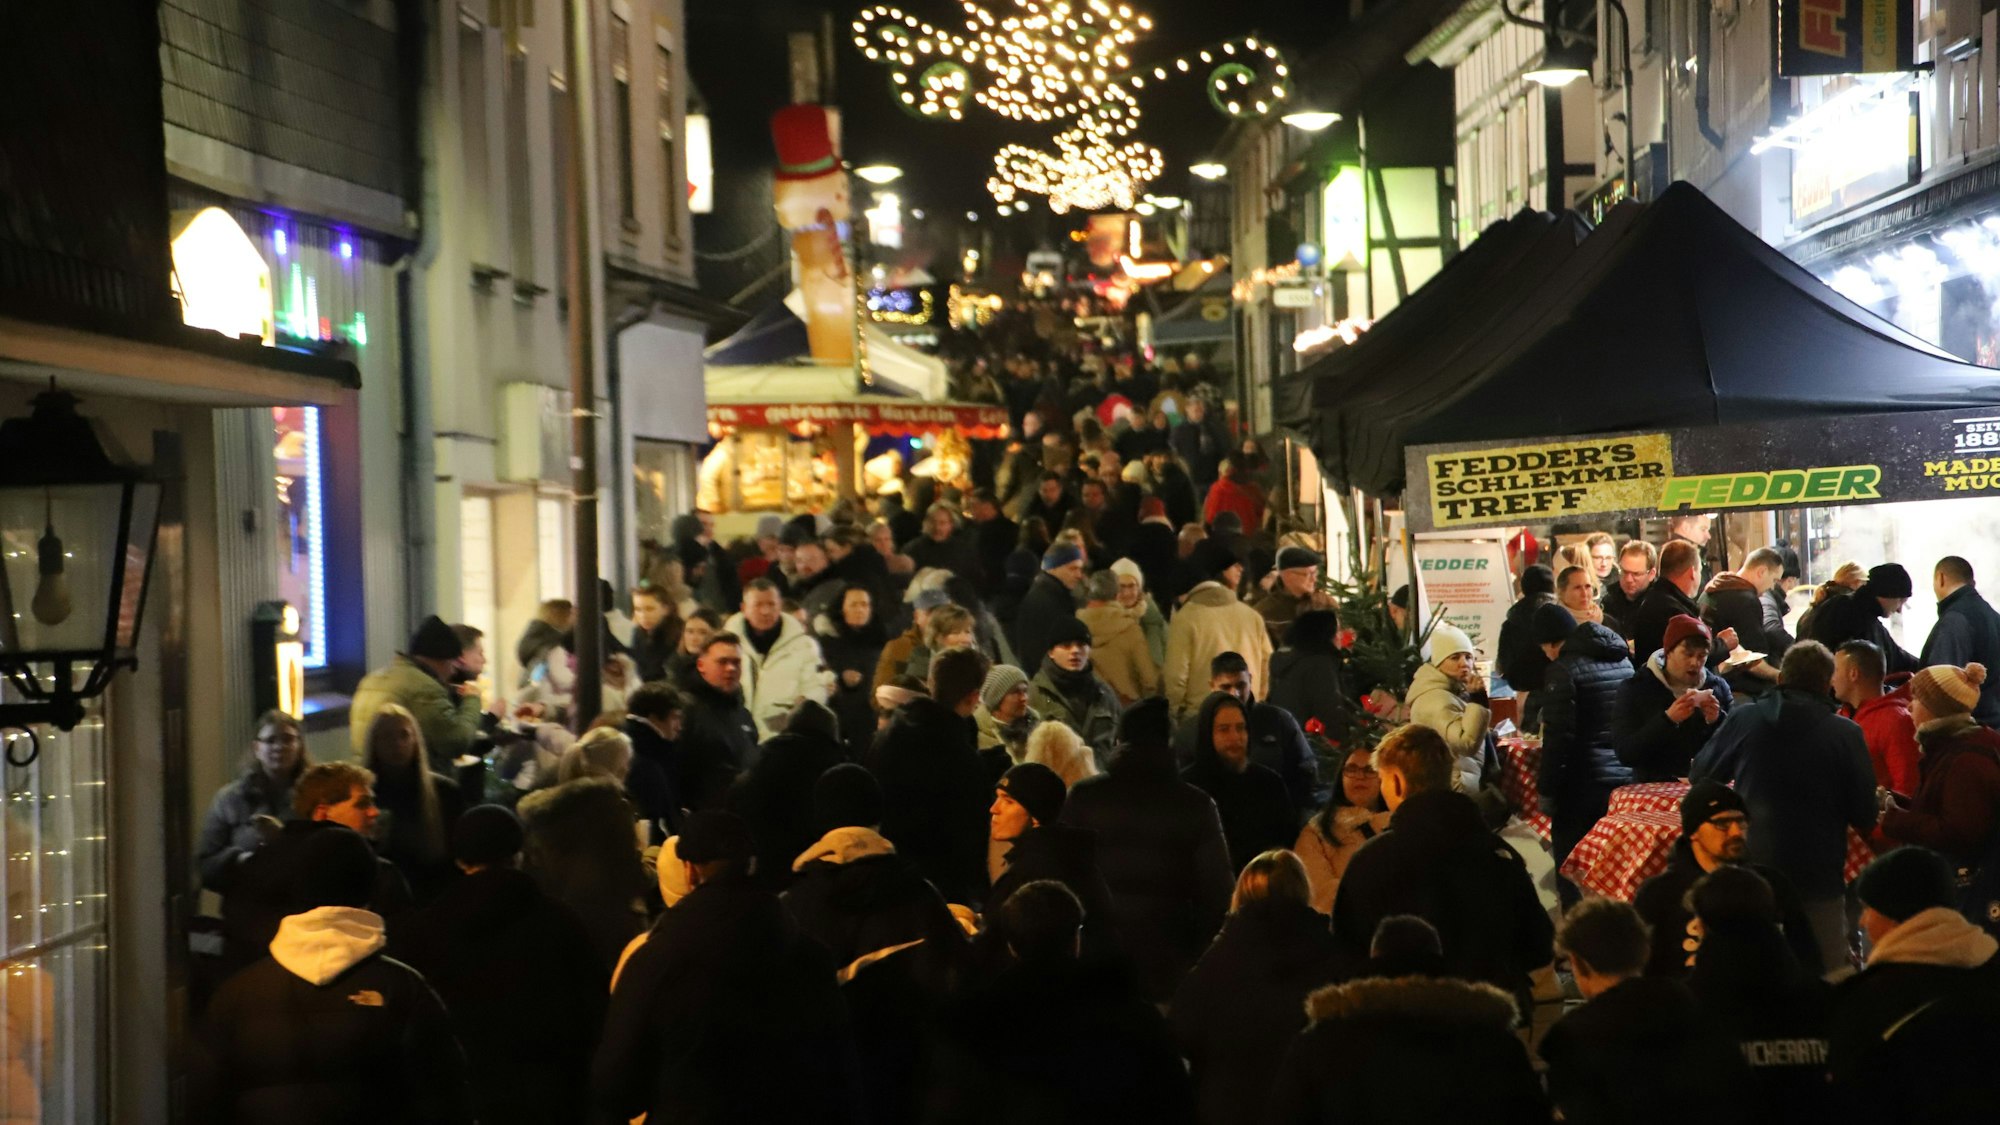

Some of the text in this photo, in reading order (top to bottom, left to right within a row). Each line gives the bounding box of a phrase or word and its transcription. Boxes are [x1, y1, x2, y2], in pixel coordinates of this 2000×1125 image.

[1800, 0, 1846, 57] F
[1871, 0, 1885, 56] Cateri
[1954, 432, 2000, 448] 188
[1965, 422, 2000, 432] SEIT
[1434, 444, 1636, 478] FEDDER'S
[1923, 457, 2000, 476] MADE
[1437, 462, 1665, 497] SCHLEMMER
[1658, 464, 1882, 511] FEDDER
[1438, 488, 1587, 520] TREFF
[1419, 558, 1488, 571] EDDER
